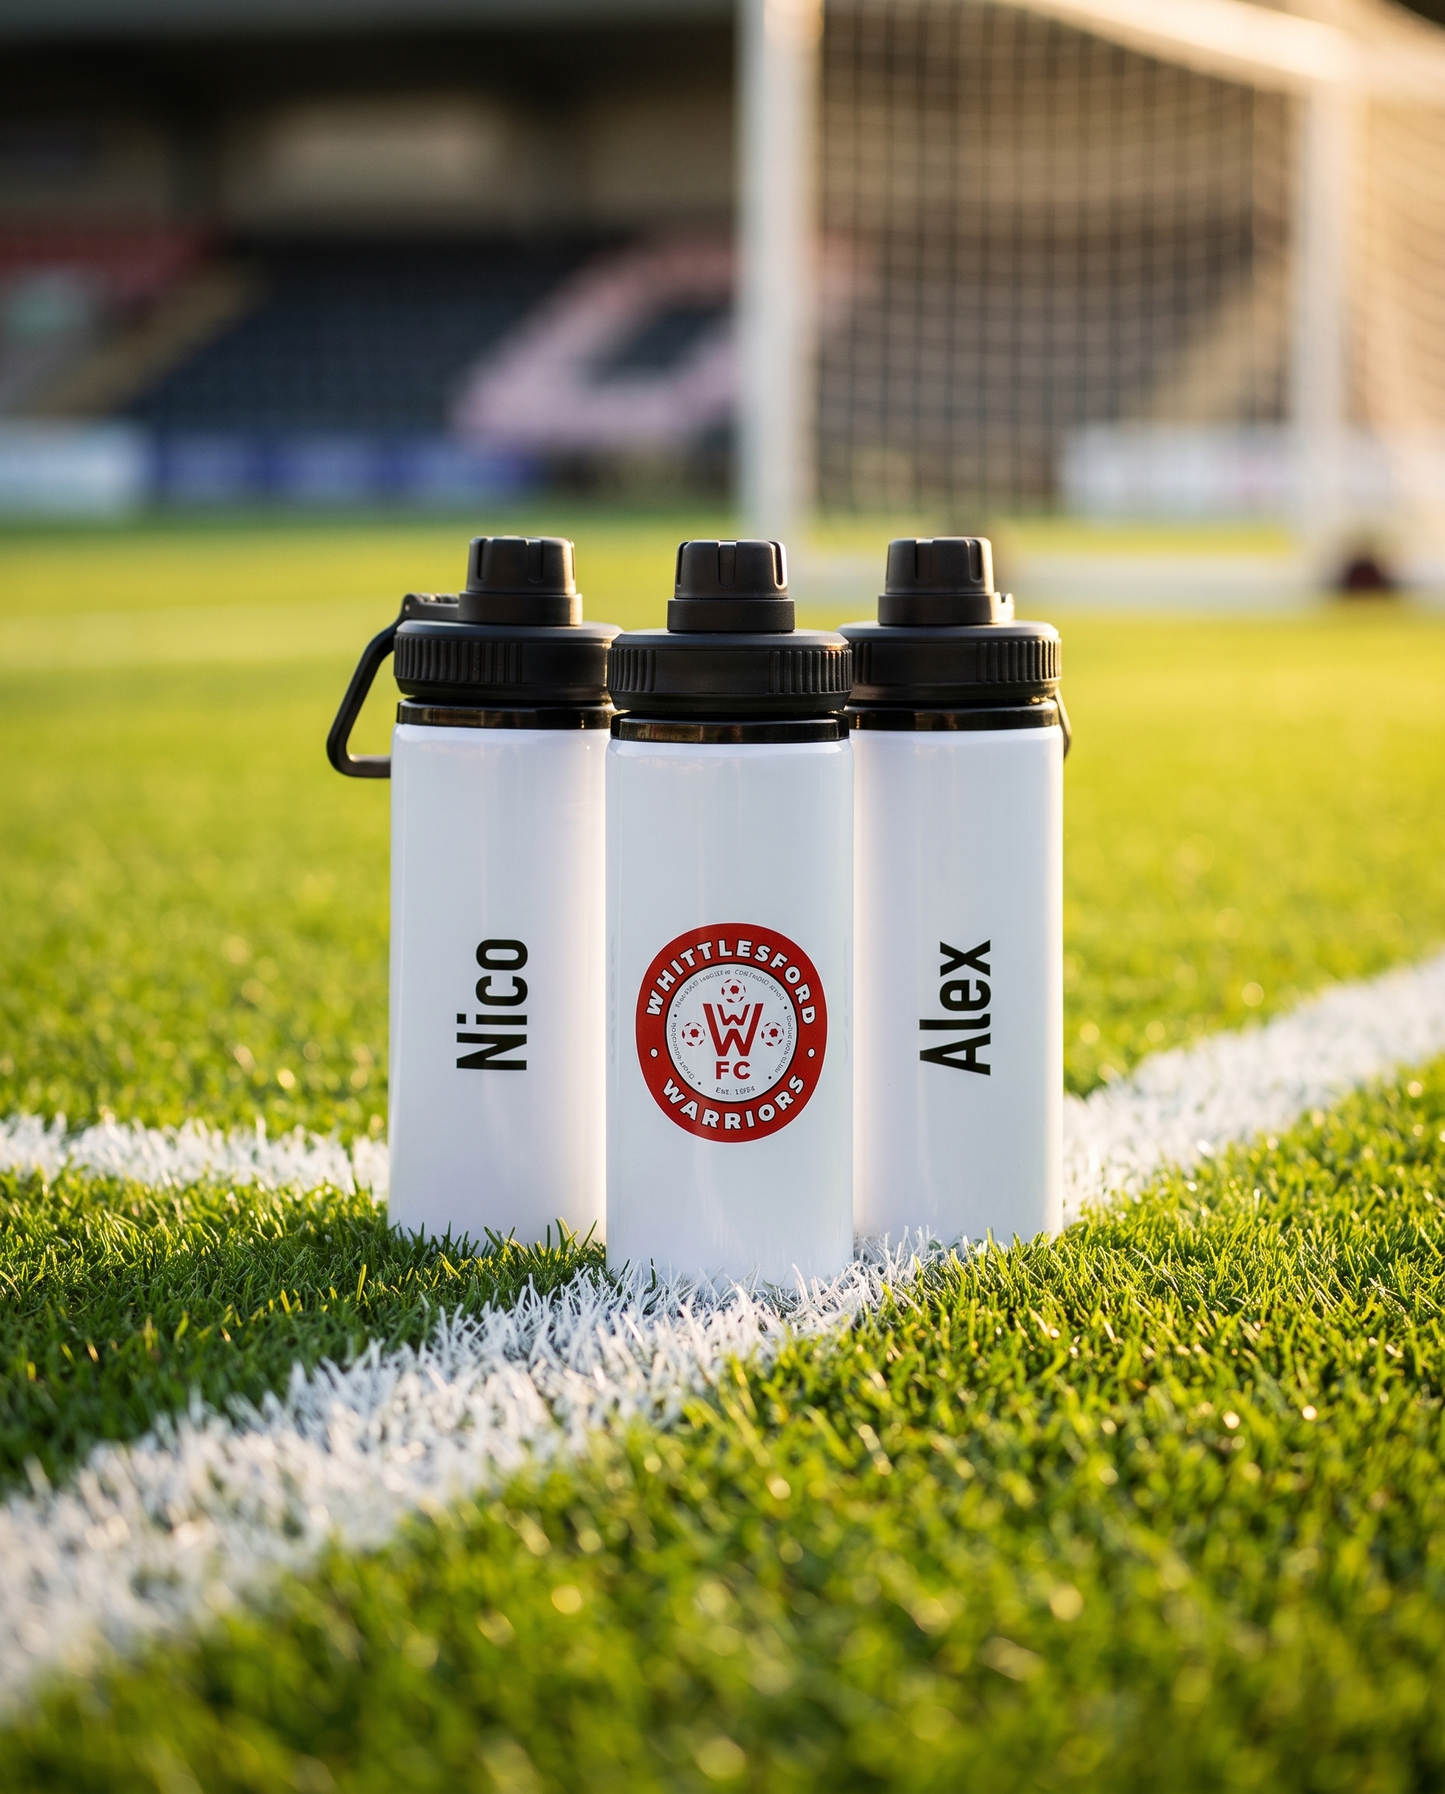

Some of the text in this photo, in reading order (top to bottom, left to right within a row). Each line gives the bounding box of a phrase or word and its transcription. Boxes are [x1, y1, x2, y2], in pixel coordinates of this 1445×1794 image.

[456, 938, 529, 1071] Nico
[646, 939, 816, 1025] WHITTLESFORD
[919, 939, 992, 1076] Alex
[662, 1075, 804, 1130] WARRIORS
[715, 1060, 751, 1080] FC
